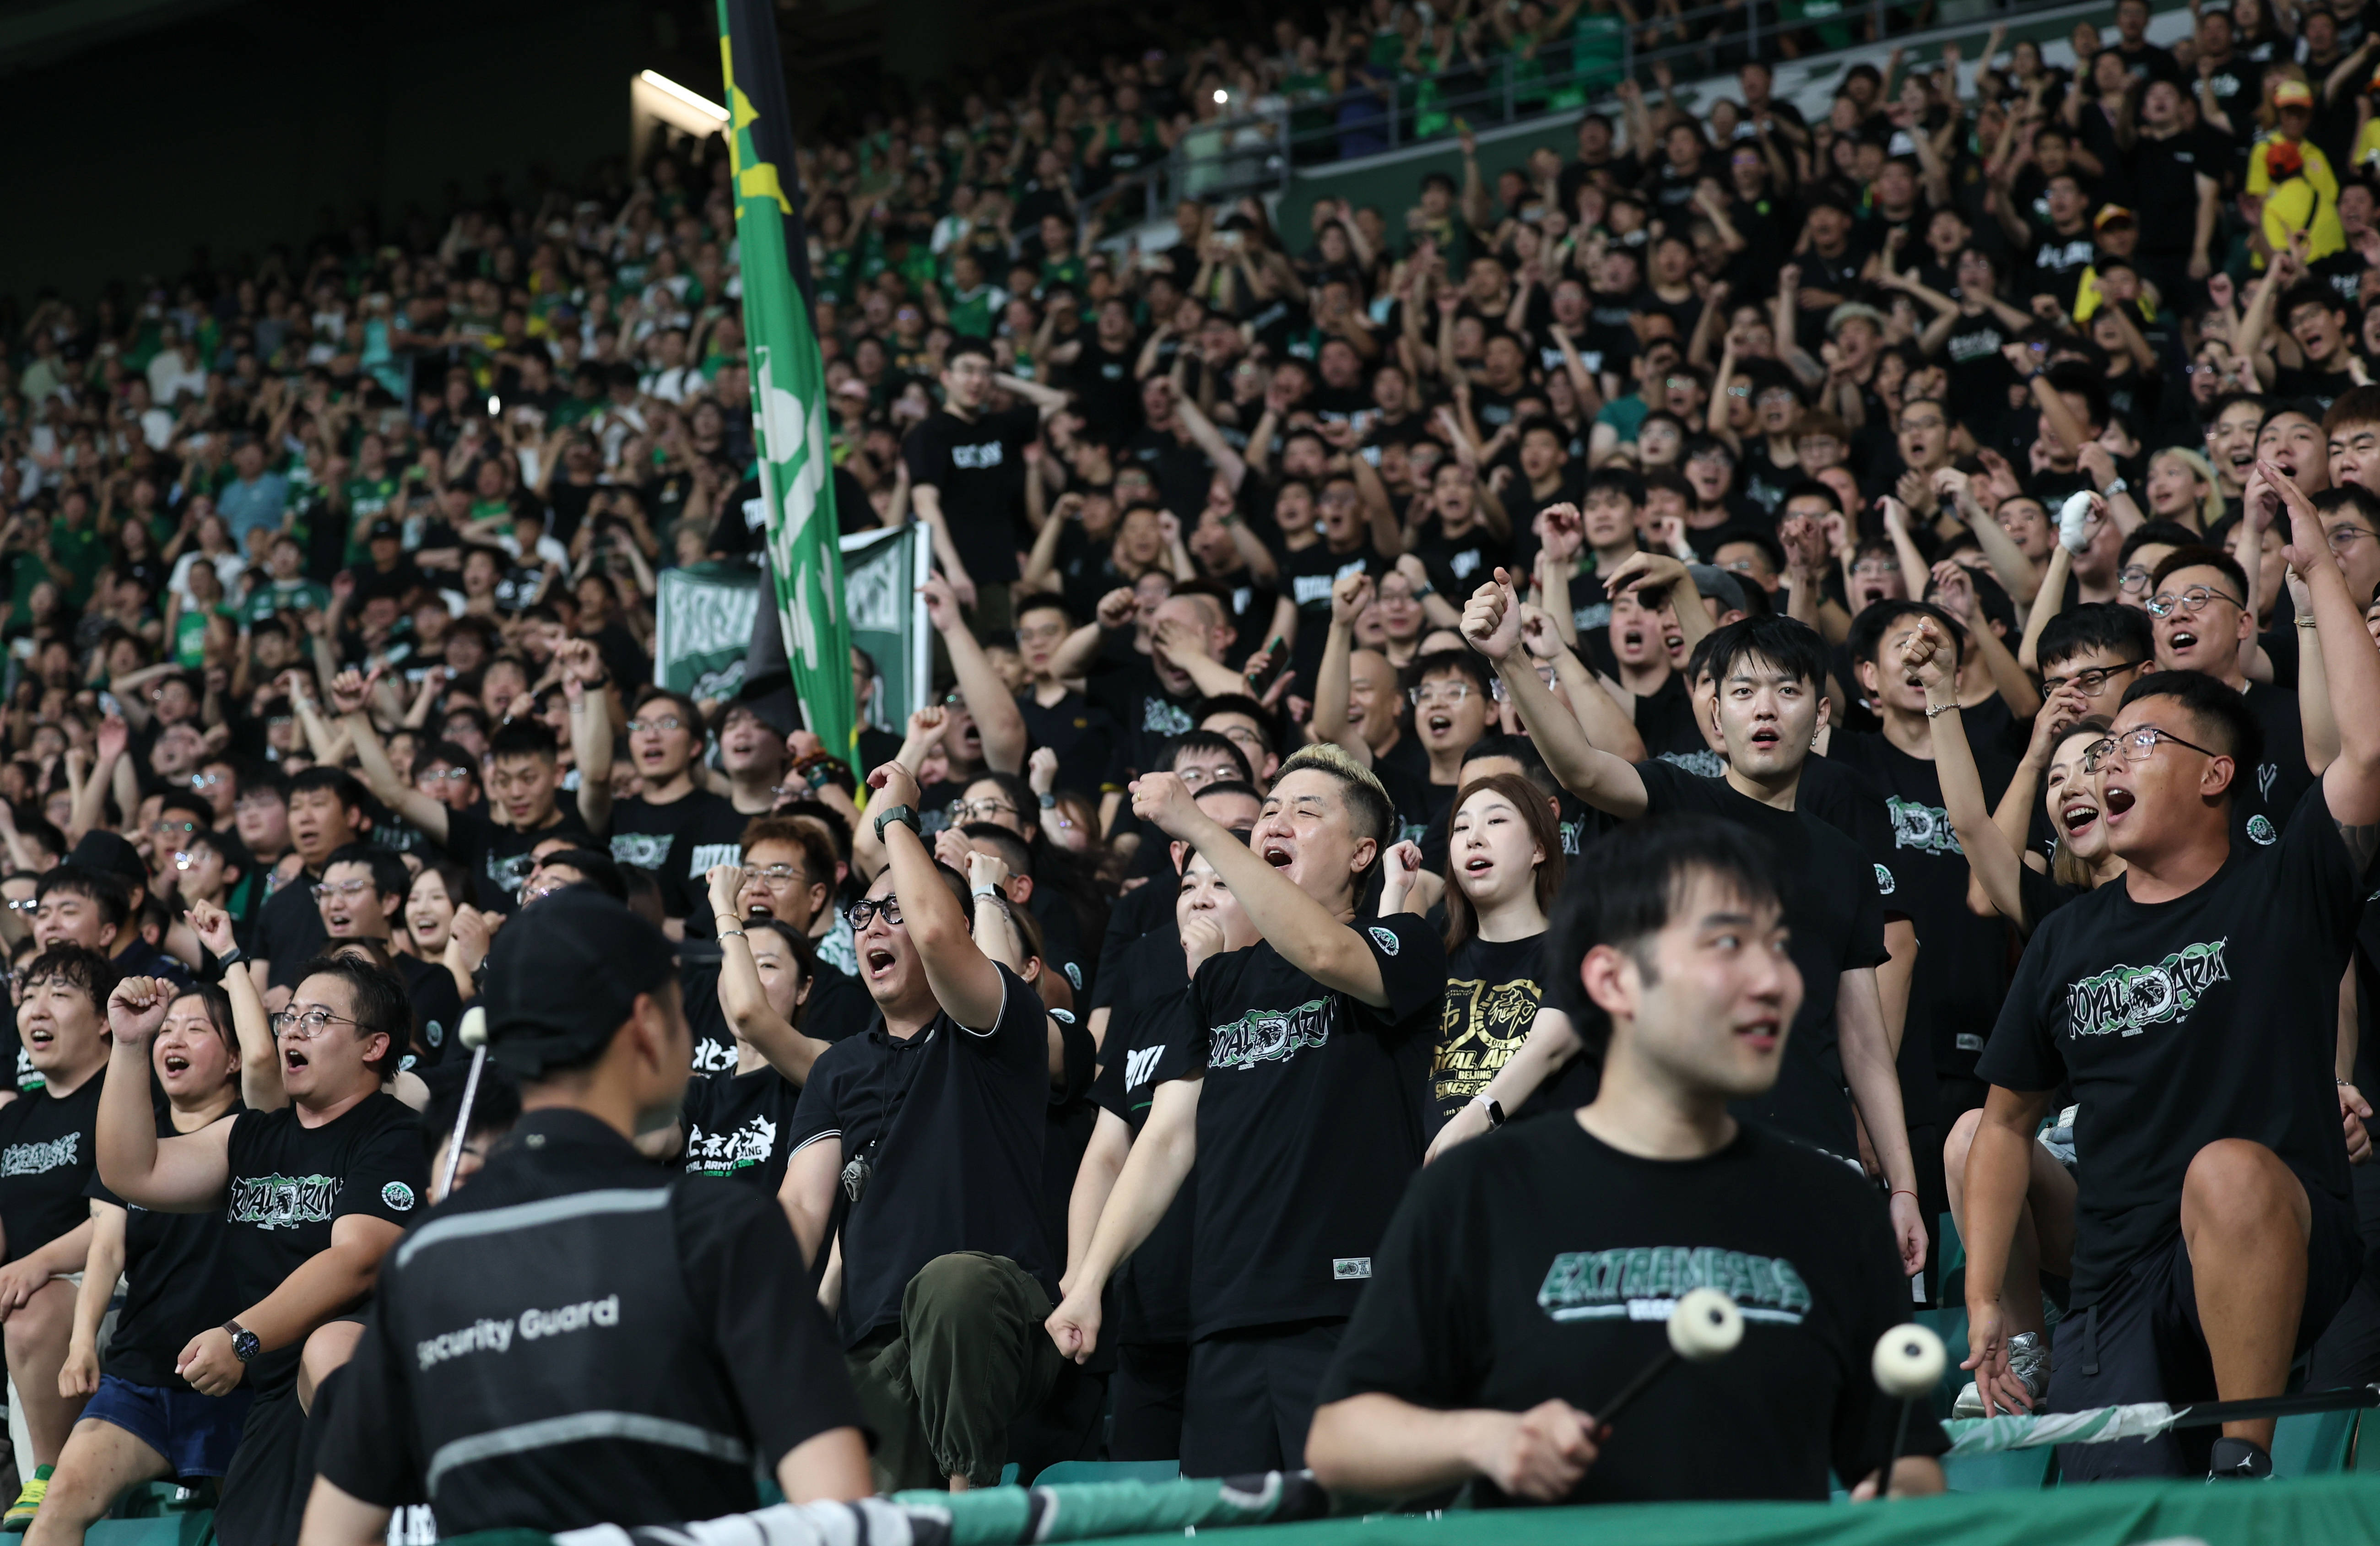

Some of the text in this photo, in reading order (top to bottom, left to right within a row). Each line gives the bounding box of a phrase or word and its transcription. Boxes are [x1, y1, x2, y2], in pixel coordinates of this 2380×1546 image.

[2122, 1028, 2143, 1037] SINCE
[1487, 1037, 1509, 1049] 2005
[704, 1160, 734, 1171] ARMY
[519, 1293, 620, 1341] Guard
